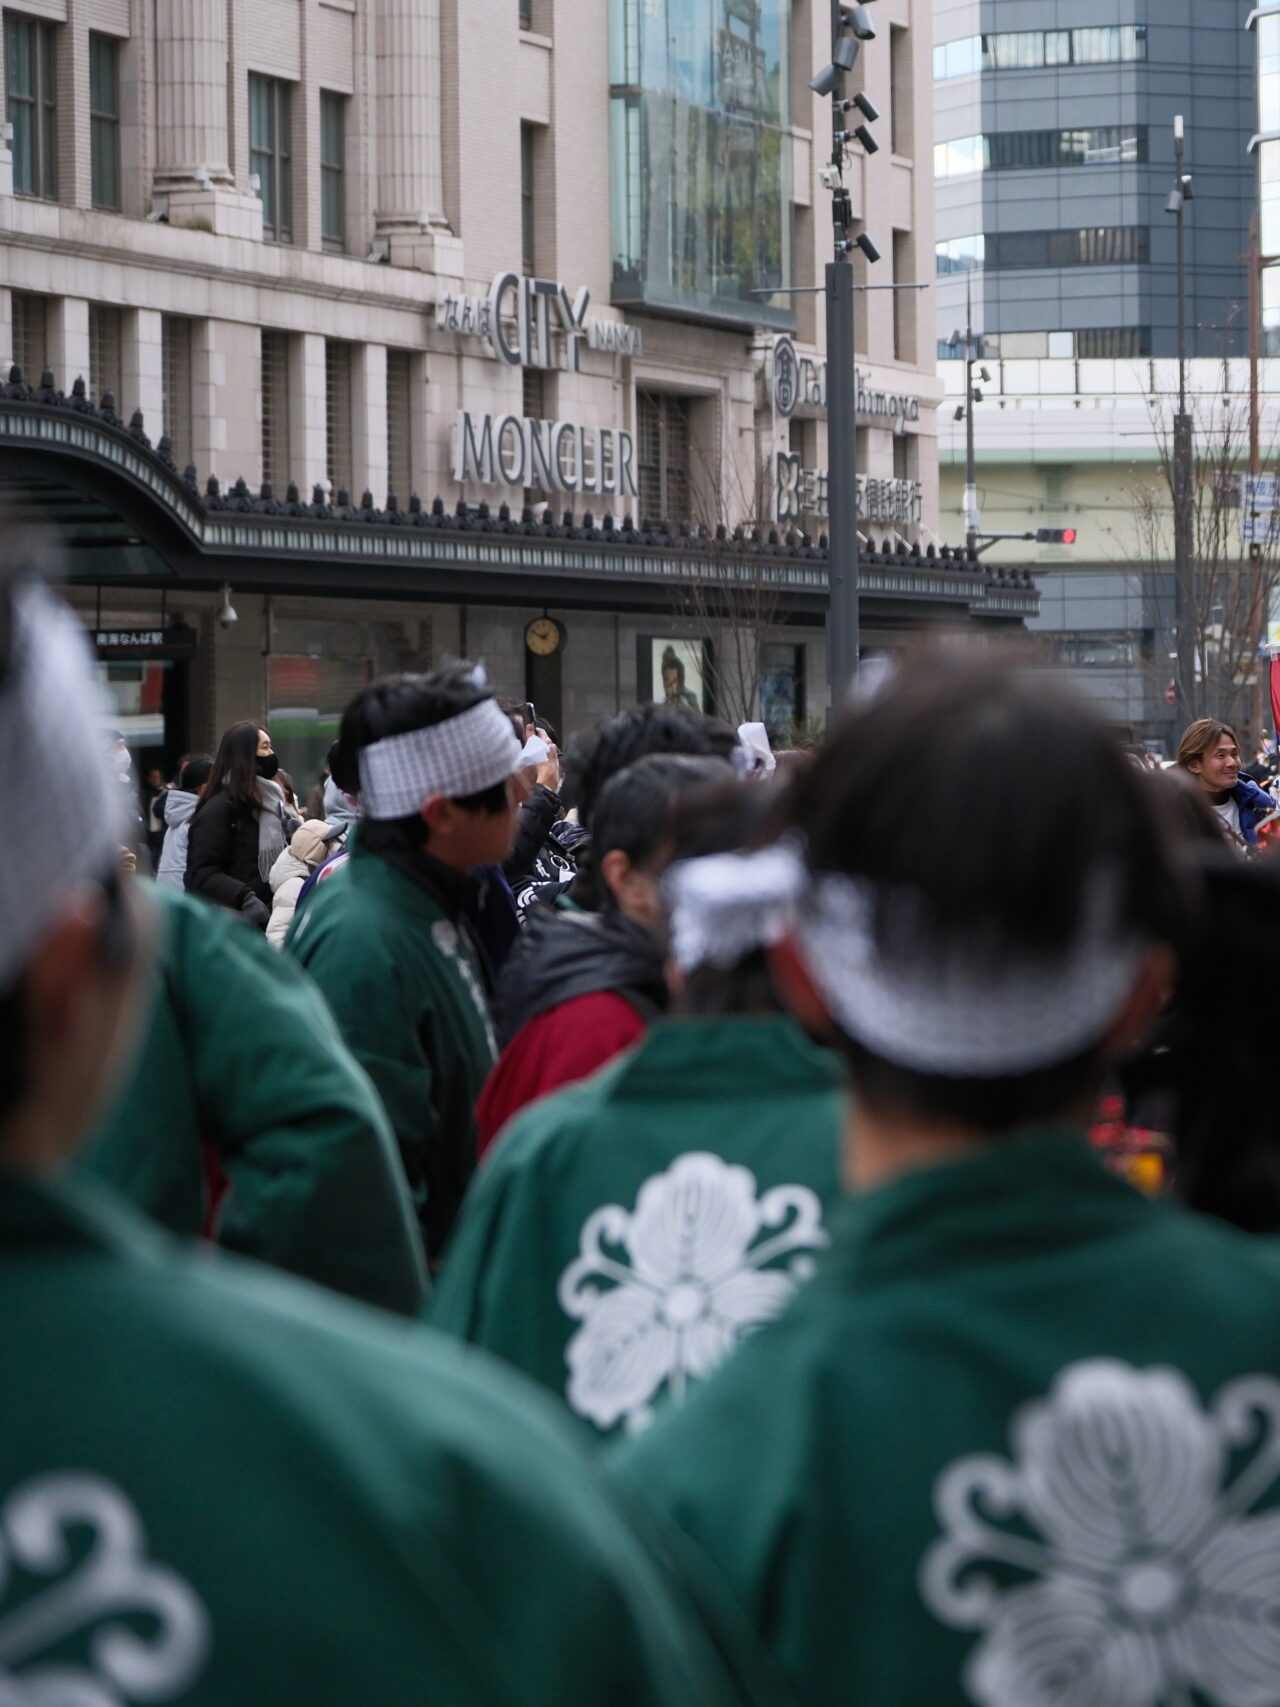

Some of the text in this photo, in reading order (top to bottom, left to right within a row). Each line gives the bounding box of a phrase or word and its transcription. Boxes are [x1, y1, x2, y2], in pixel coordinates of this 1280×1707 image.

[493, 273, 590, 372] CITY
[799, 358, 919, 428] Tahimaya
[456, 411, 639, 498] MONCLER
[801, 470, 922, 521] 三井友信託銀行
